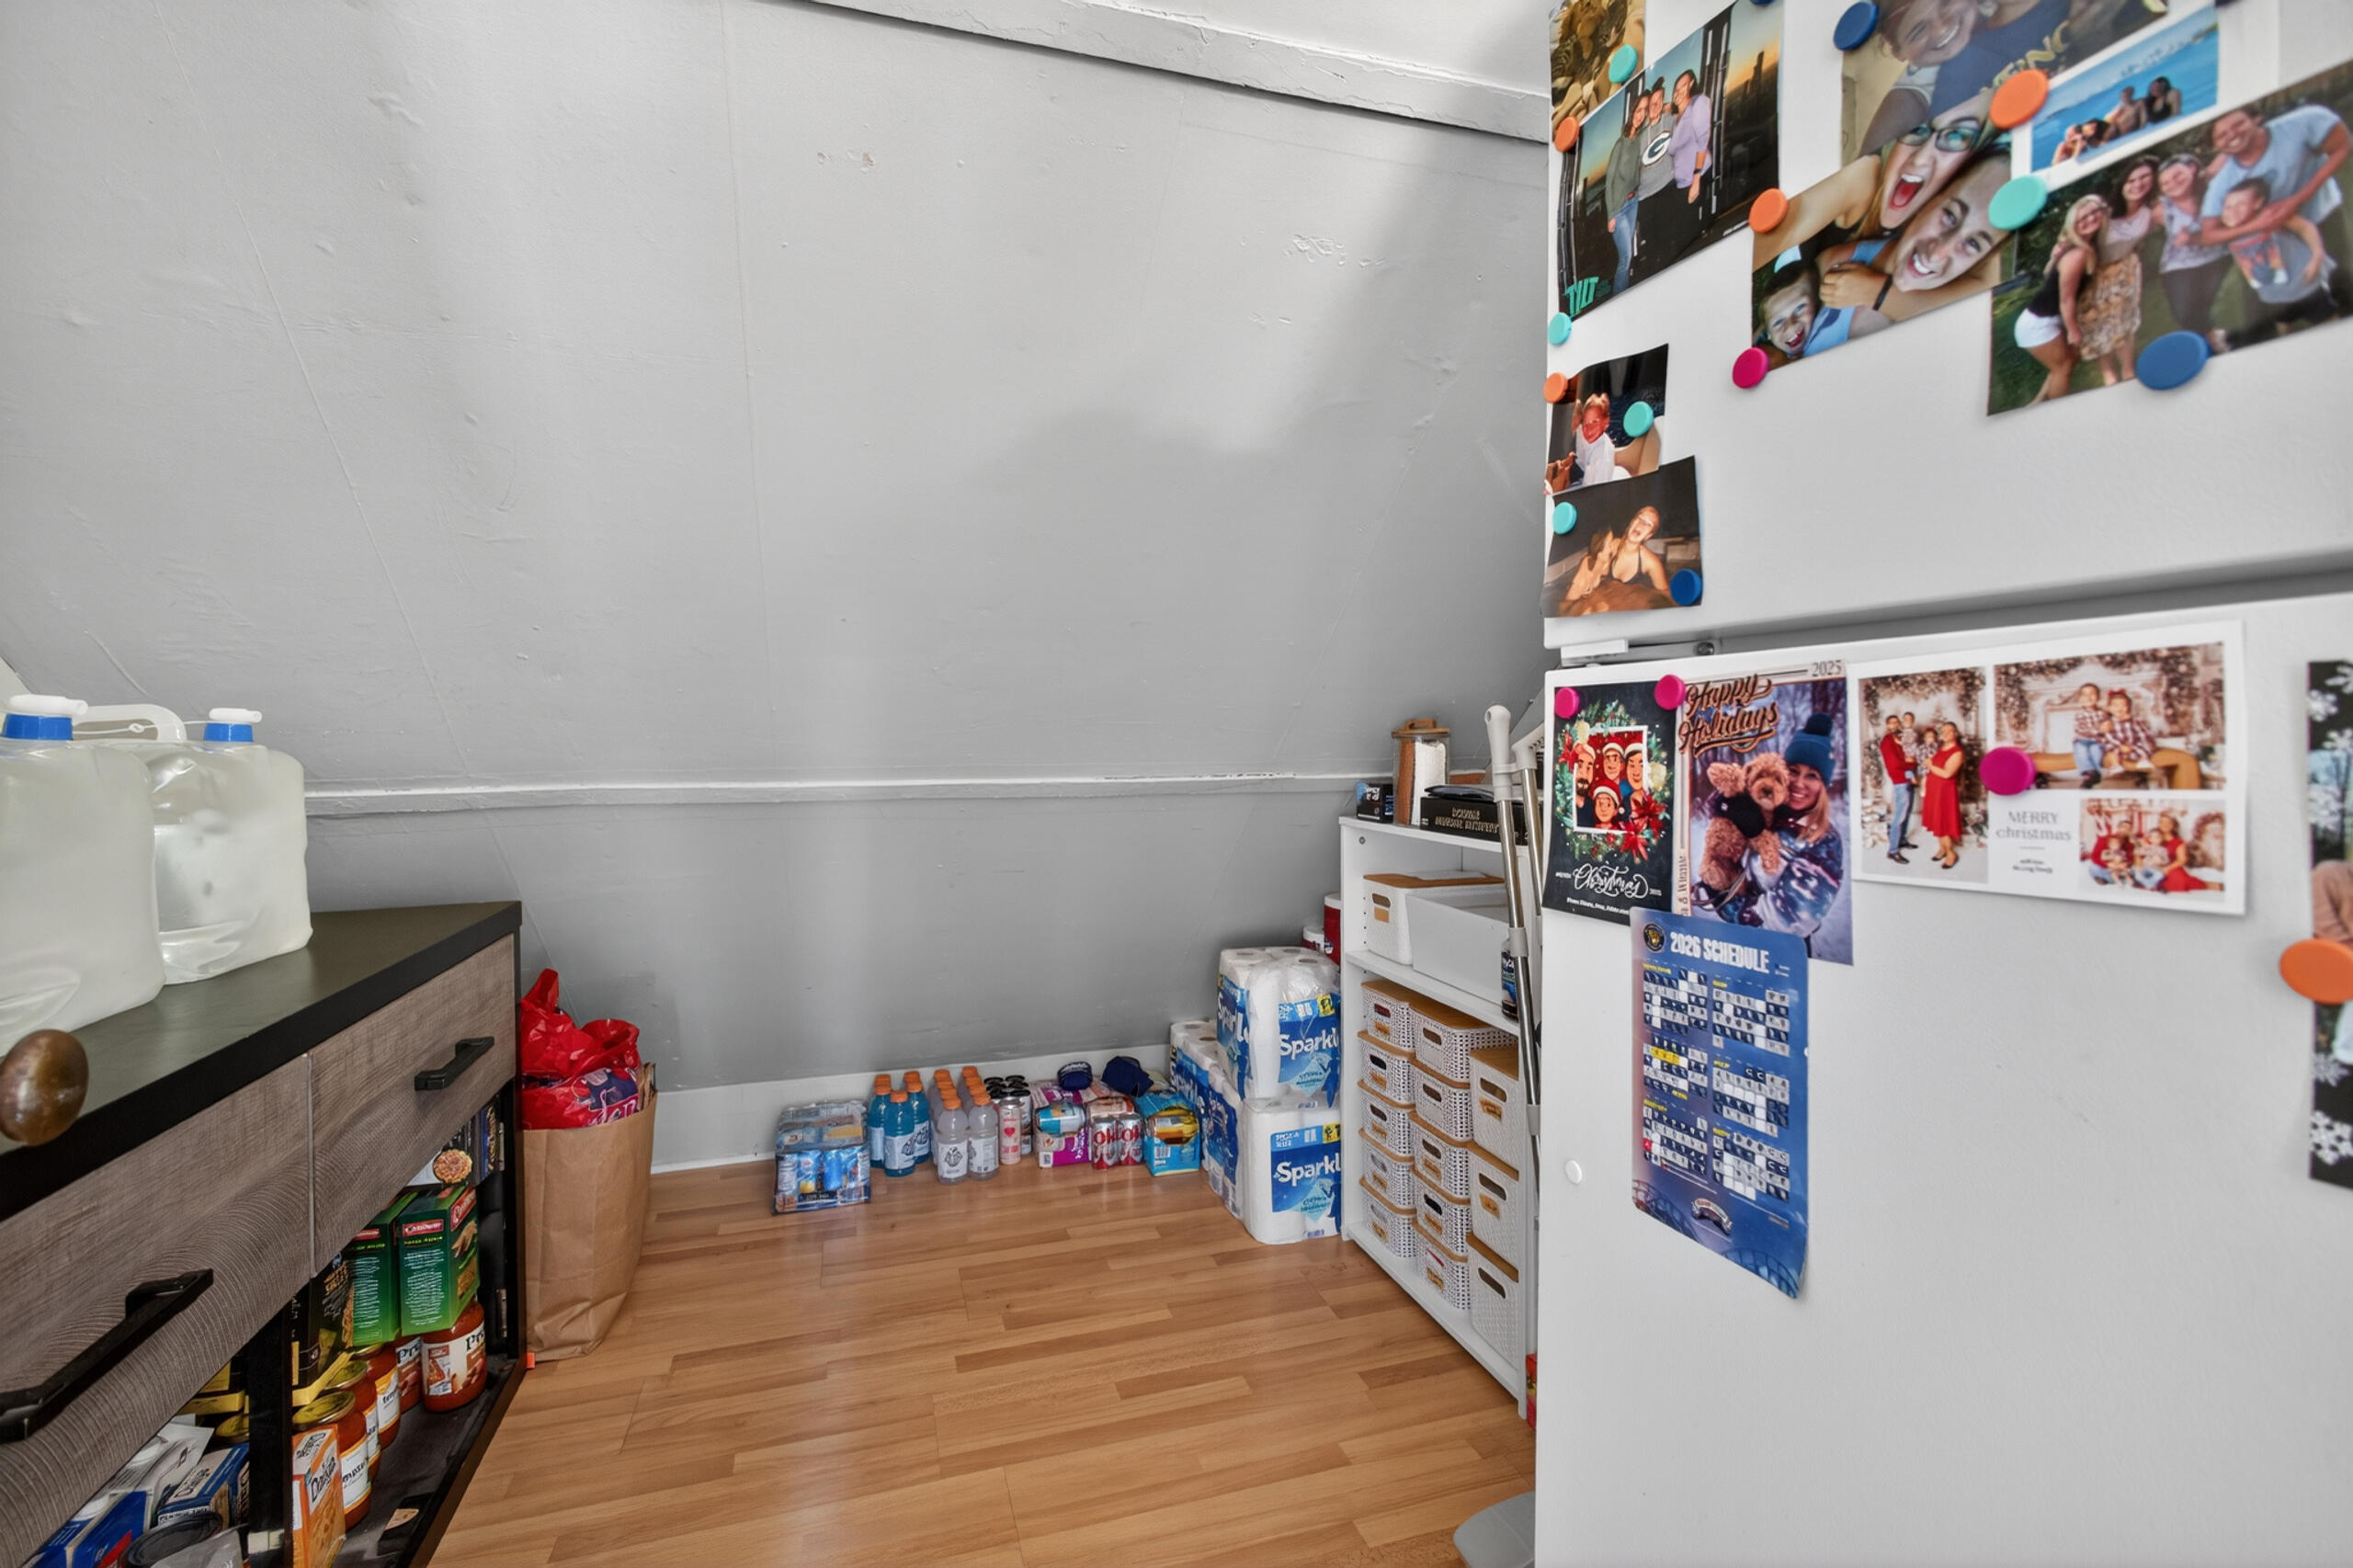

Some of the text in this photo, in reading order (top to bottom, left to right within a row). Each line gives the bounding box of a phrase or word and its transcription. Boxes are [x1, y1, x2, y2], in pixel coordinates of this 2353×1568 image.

[1565, 276, 1599, 317] TILT
[1812, 660, 1842, 677] 2025
[1685, 674, 1773, 718] Happy
[1678, 701, 1780, 757] Holidays
[1995, 826, 2072, 841] christmas
[2008, 811, 2058, 824] MERRY
[1573, 862, 1649, 899] Christmas
[1669, 931, 1700, 960] 2026
[1702, 937, 1770, 974] SCHEDULE
[1279, 1028, 1338, 1061] Sparkl
[1276, 1153, 1342, 1187] Sparkl
